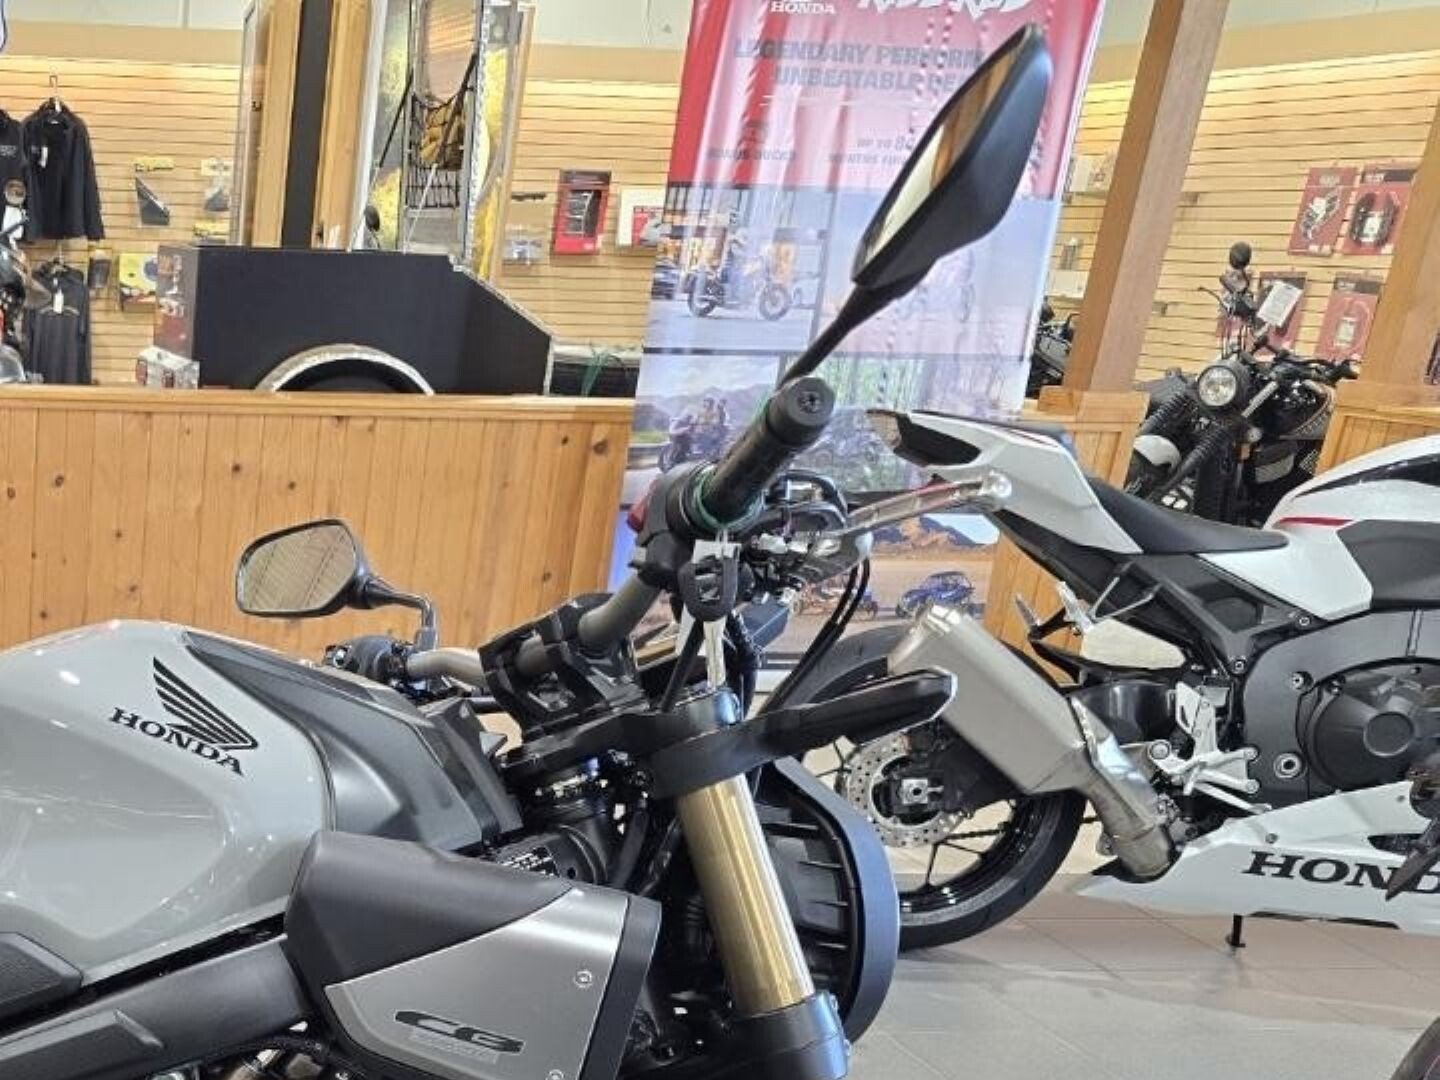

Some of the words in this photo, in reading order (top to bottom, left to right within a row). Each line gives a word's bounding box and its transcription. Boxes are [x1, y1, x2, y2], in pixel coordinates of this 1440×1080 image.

[770, 0, 837, 14] HONDA
[734, 38, 871, 64] LEGENDARY
[776, 66, 924, 91] UNBEATABLE
[109, 706, 245, 778] HONDA
